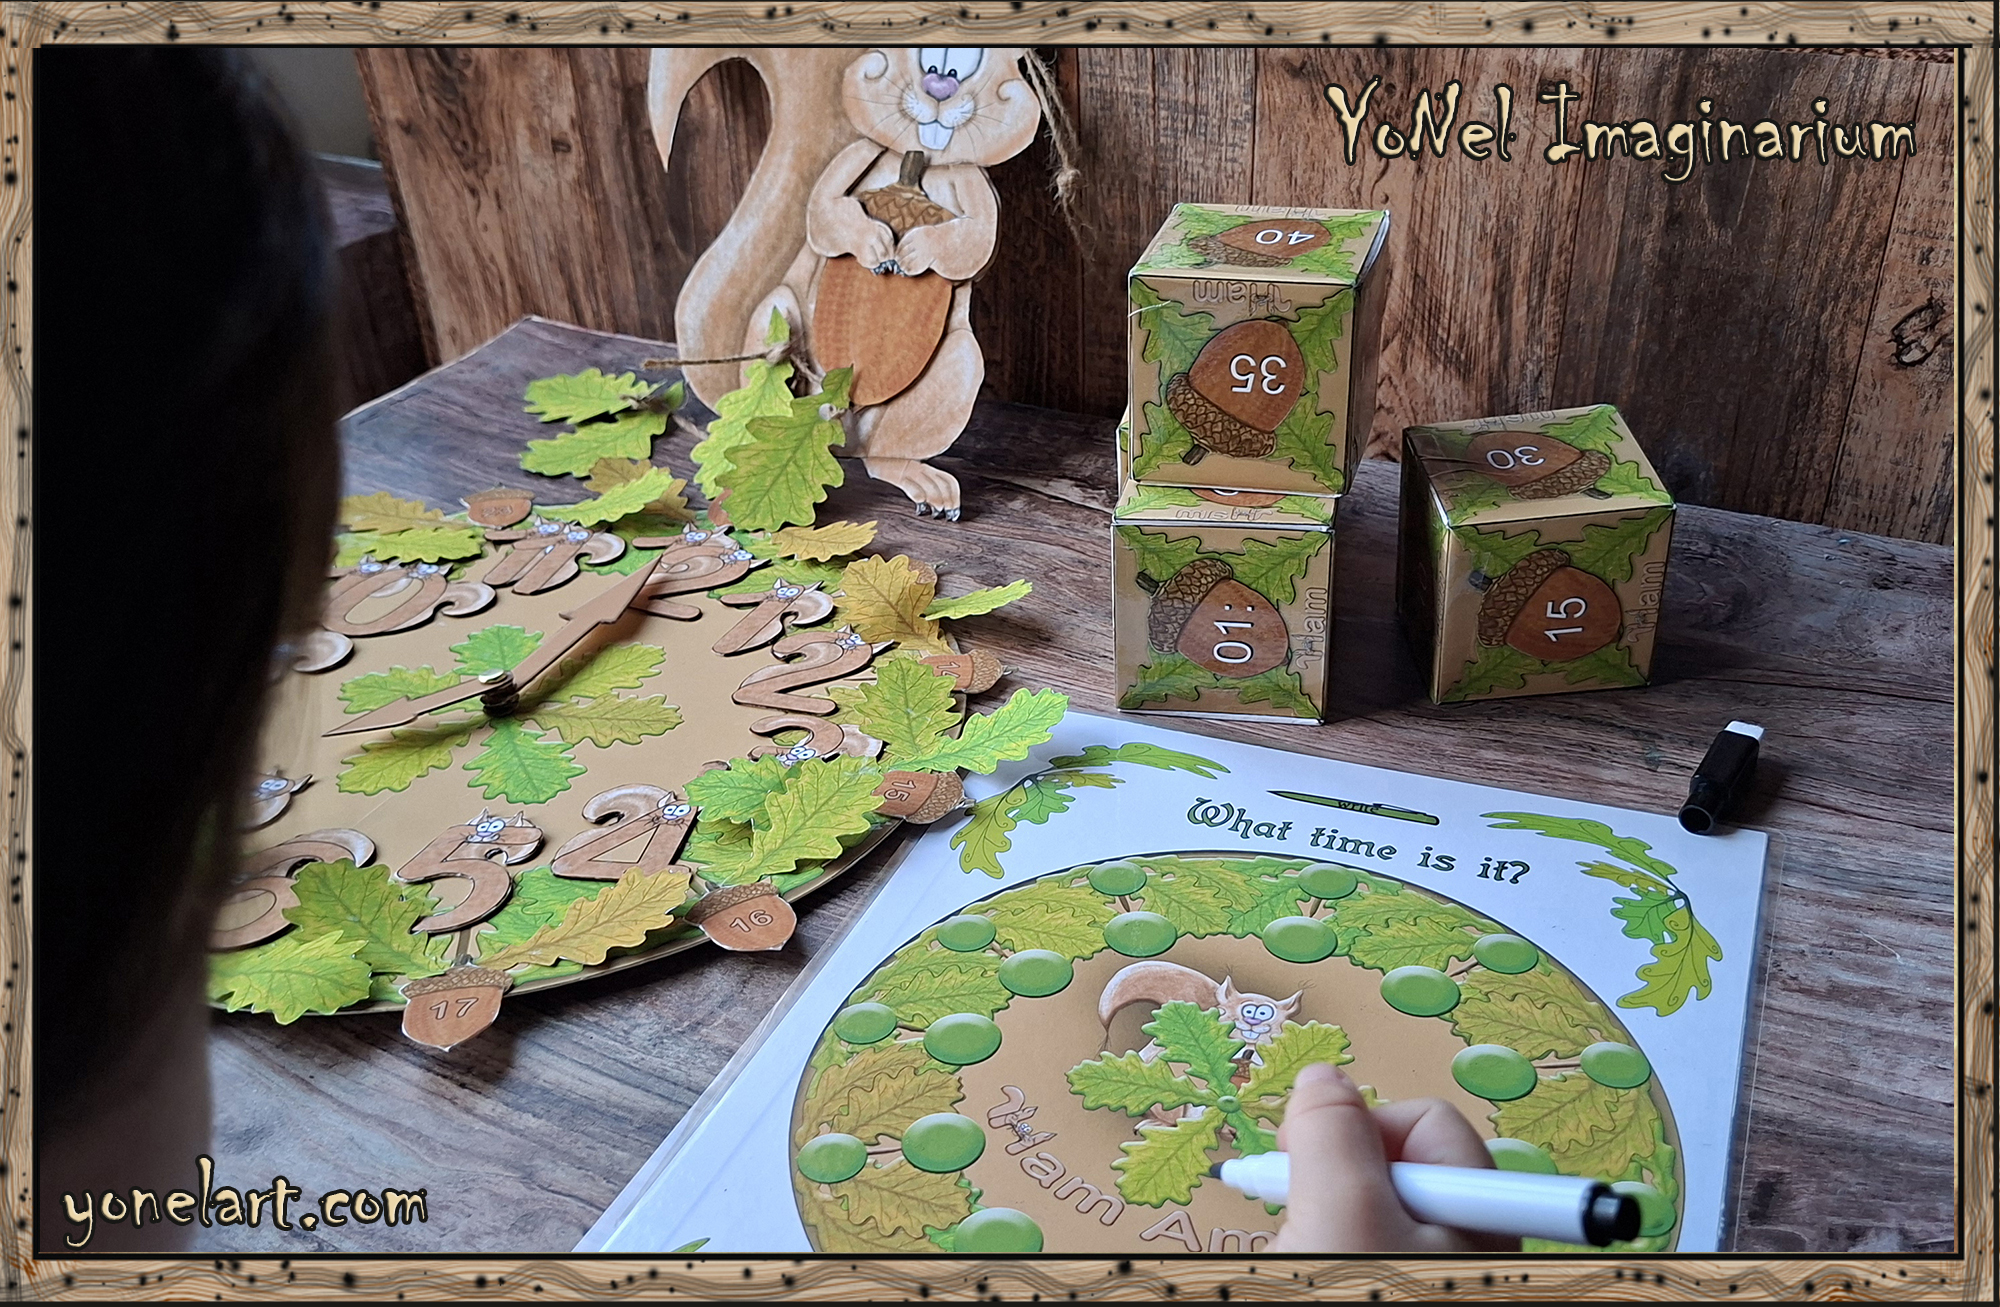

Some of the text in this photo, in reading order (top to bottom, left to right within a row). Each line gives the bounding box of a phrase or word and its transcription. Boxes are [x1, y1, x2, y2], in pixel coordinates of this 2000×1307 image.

[1255, 229, 1315, 245] 40
[1192, 279, 1292, 315] Ham
[1230, 354, 1287, 394] 35
[1486, 446, 1545, 469] 30
[1291, 586, 1328, 669] Ham
[1544, 597, 1588, 642] 15
[882, 777, 916, 803] 15
[1186, 797, 1531, 885] What time is it?
[729, 909, 774, 933] 16
[428, 996, 480, 1020] 17
